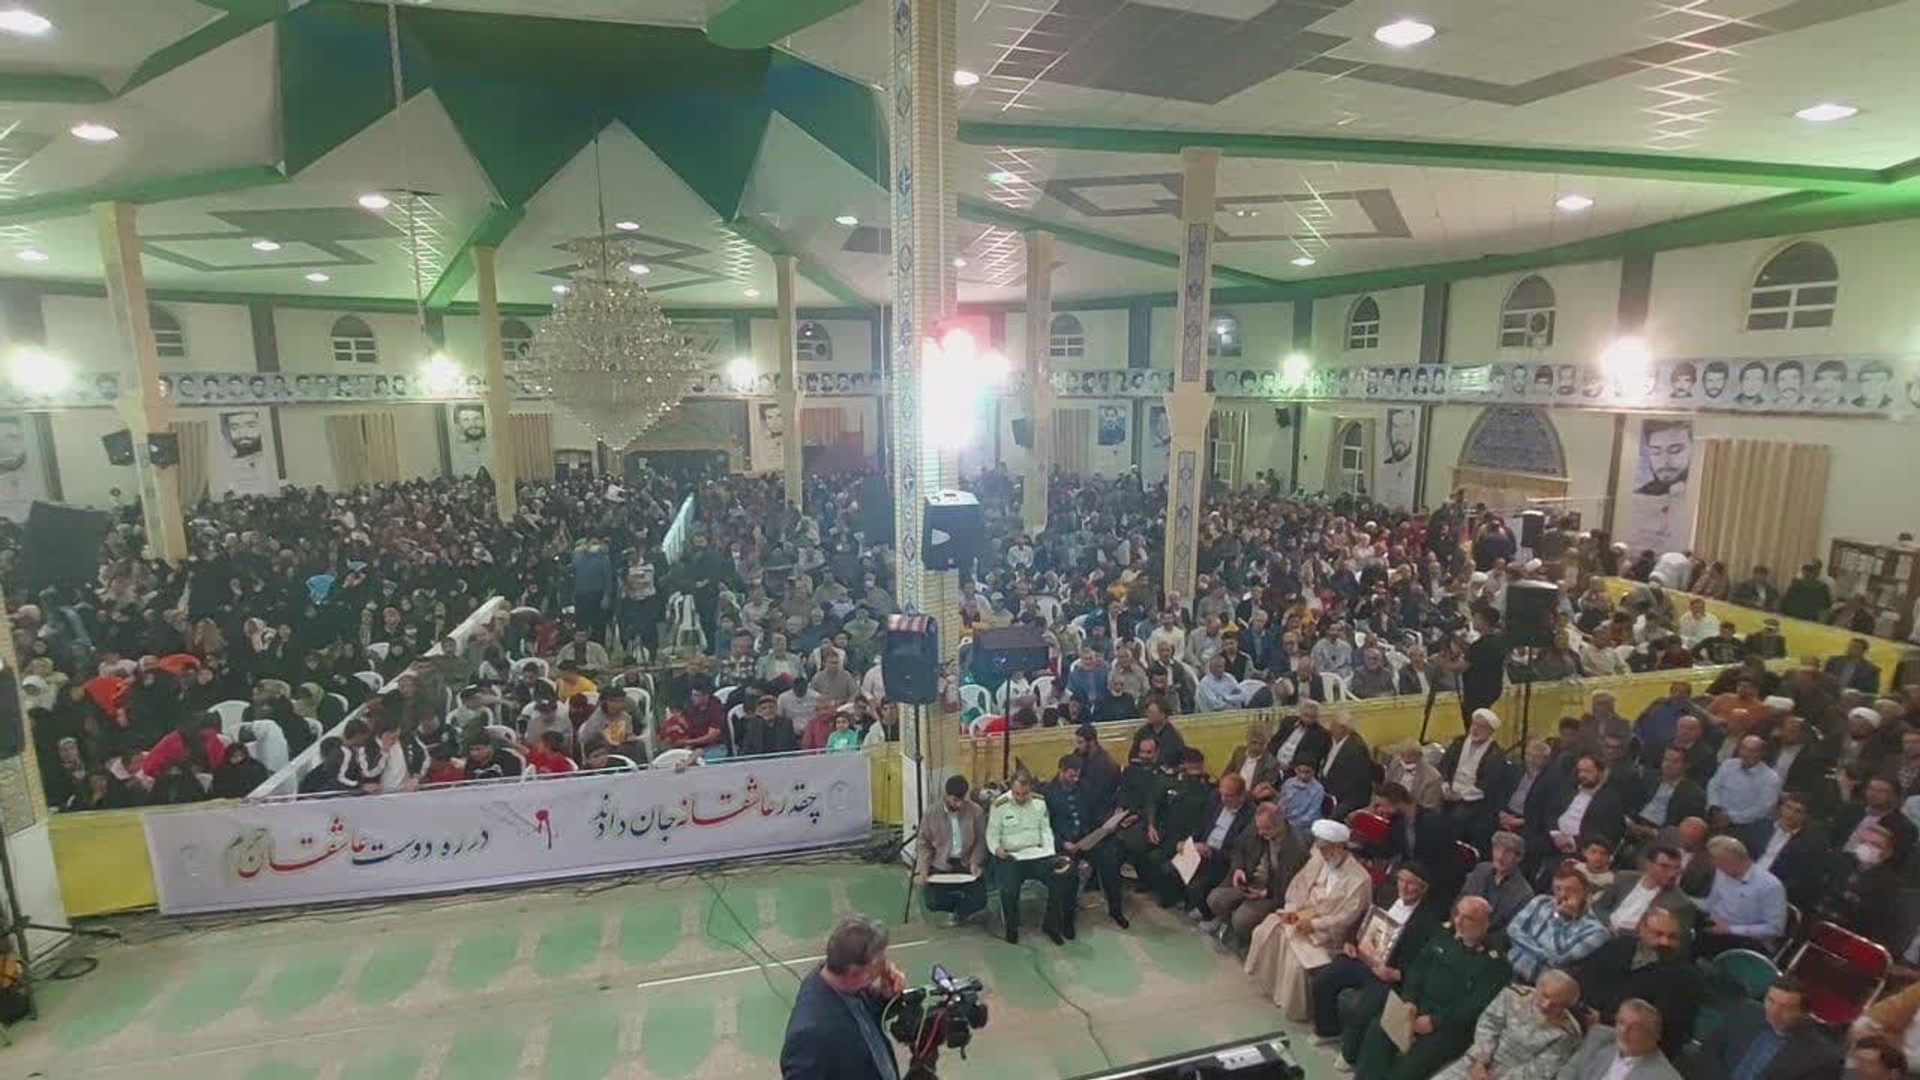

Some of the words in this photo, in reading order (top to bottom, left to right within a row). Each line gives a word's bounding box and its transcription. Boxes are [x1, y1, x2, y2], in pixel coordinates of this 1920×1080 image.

[589, 793, 626, 839] دادند
[676, 777, 774, 828] عاشقانه
[777, 784, 820, 824] چقدر
[466, 829, 489, 851] در
[630, 809, 676, 842] جان
[237, 816, 366, 879] عاشقان
[352, 838, 433, 866] دوست
